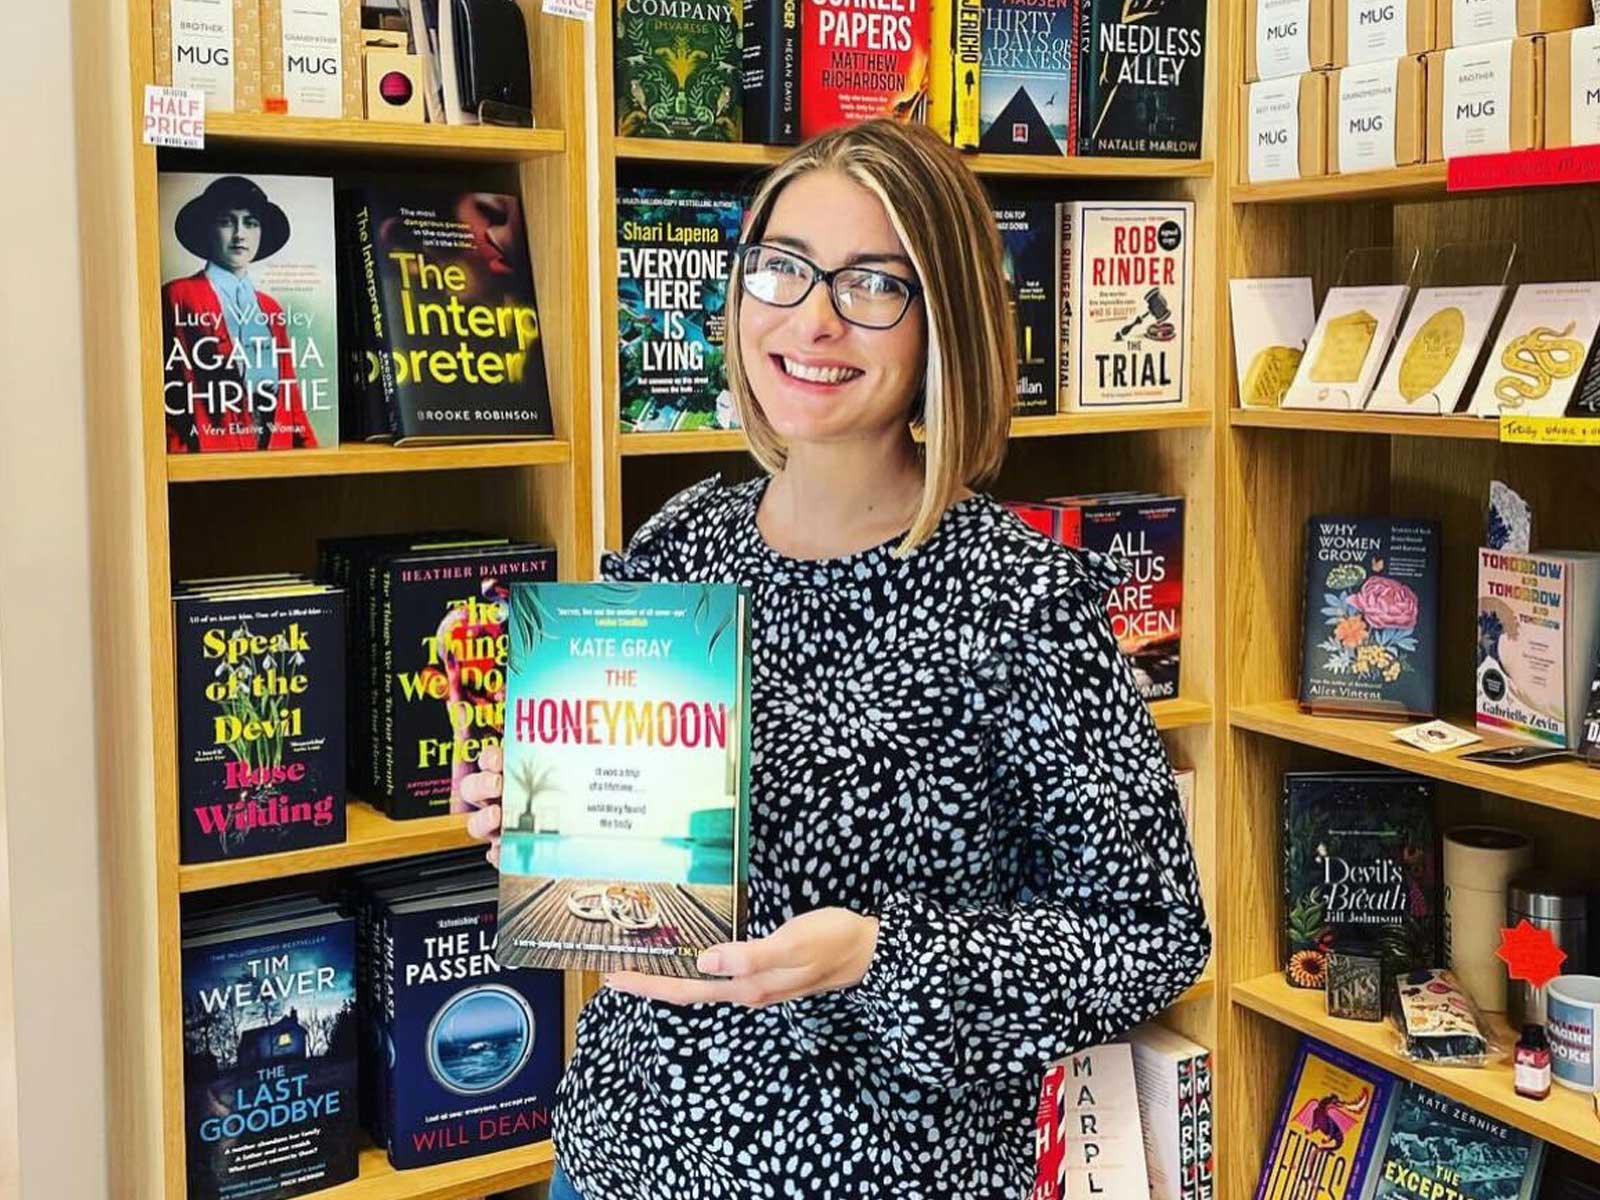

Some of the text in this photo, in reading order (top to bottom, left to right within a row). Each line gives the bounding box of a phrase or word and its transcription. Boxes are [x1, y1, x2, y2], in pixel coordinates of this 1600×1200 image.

[626, 0, 734, 23] COMPANY
[980, 8, 1056, 34] HIRTY
[1360, 5, 1394, 25] MUG
[180, 21, 224, 33] BROTHER
[819, 10, 912, 51] PAPERS
[994, 29, 1049, 52] DAYS
[1100, 23, 1201, 57] NEEDLESS
[1267, 22, 1297, 40] MUG
[177, 45, 229, 66] MUG
[288, 55, 337, 75] MUG
[831, 52, 897, 73] MATTHEW
[981, 48, 1071, 70] ARKNESS
[821, 70, 905, 92] RICHARDSON
[1118, 55, 1185, 86] ALLEY
[150, 95, 200, 117] HALF
[1456, 100, 1495, 120] MUG
[144, 115, 204, 138] PRICE
[1258, 129, 1288, 146] MUG
[1350, 115, 1383, 133] MUG
[1098, 139, 1198, 152] NATALIE MARLOW
[623, 221, 719, 246] Shari Lapena
[1114, 225, 1157, 255] ROB
[357, 206, 383, 338] The Interpreter
[389, 252, 466, 291] The
[617, 248, 729, 280] EVERYONE
[1092, 257, 1175, 286] RINDER
[644, 280, 703, 309] HERE
[174, 303, 315, 330] Lucy Worsley
[401, 290, 539, 350] Interp
[664, 311, 685, 340] IS
[165, 336, 324, 371] AGATHA
[643, 341, 704, 371] LYING
[1127, 340, 1142, 351] THE
[1095, 352, 1171, 388] TRIAL
[163, 378, 331, 415] CHRISTIE
[190, 426, 199, 436] A
[203, 425, 225, 436] Very
[269, 422, 306, 434] Woman
[417, 410, 538, 421] BROOKE ROBINSON
[1319, 536, 1381, 550] WOMEN
[1320, 523, 1357, 536] WHY
[1108, 531, 1153, 556] ALL
[1318, 550, 1367, 562] GROW
[402, 560, 547, 582] HEATHER DARWENT
[1135, 556, 1165, 582] US
[1482, 552, 1562, 580] TOMORROW
[1106, 585, 1153, 612] ARE
[1488, 581, 1561, 608] TOMORROW
[447, 596, 509, 627] The
[1111, 609, 1175, 640] OKEN
[1519, 613, 1560, 630] TOMORROW
[203, 622, 311, 664] Speak
[422, 627, 508, 667] Thing
[570, 638, 673, 658] KATE GRAY
[205, 667, 308, 701] of the
[398, 670, 449, 702] We
[605, 670, 637, 687] THE
[1309, 685, 1381, 699] Alice Vincent
[214, 708, 303, 745] Devil
[516, 698, 727, 749] HONEYMOON
[1482, 701, 1559, 733] Gabrielle Zevin
[224, 761, 306, 790] Rose
[194, 795, 334, 835] Wilding
[1324, 857, 1403, 884] Devil's
[1322, 883, 1407, 911] Breath
[1324, 911, 1403, 924] Jill Johnson
[424, 933, 470, 959] THE
[248, 954, 289, 978] TIM
[406, 955, 501, 987] PASSEN
[200, 967, 336, 1014] WEAVER
[1550, 1041, 1591, 1065] OOKS
[257, 1065, 287, 1081] THE
[237, 1074, 309, 1111] LAST
[200, 1091, 341, 1142] GOODBYE
[412, 1107, 548, 1153] WILL DEAN
[1418, 1094, 1508, 1139] KATE ZERNIKE
[1436, 1165, 1461, 1187] THE
